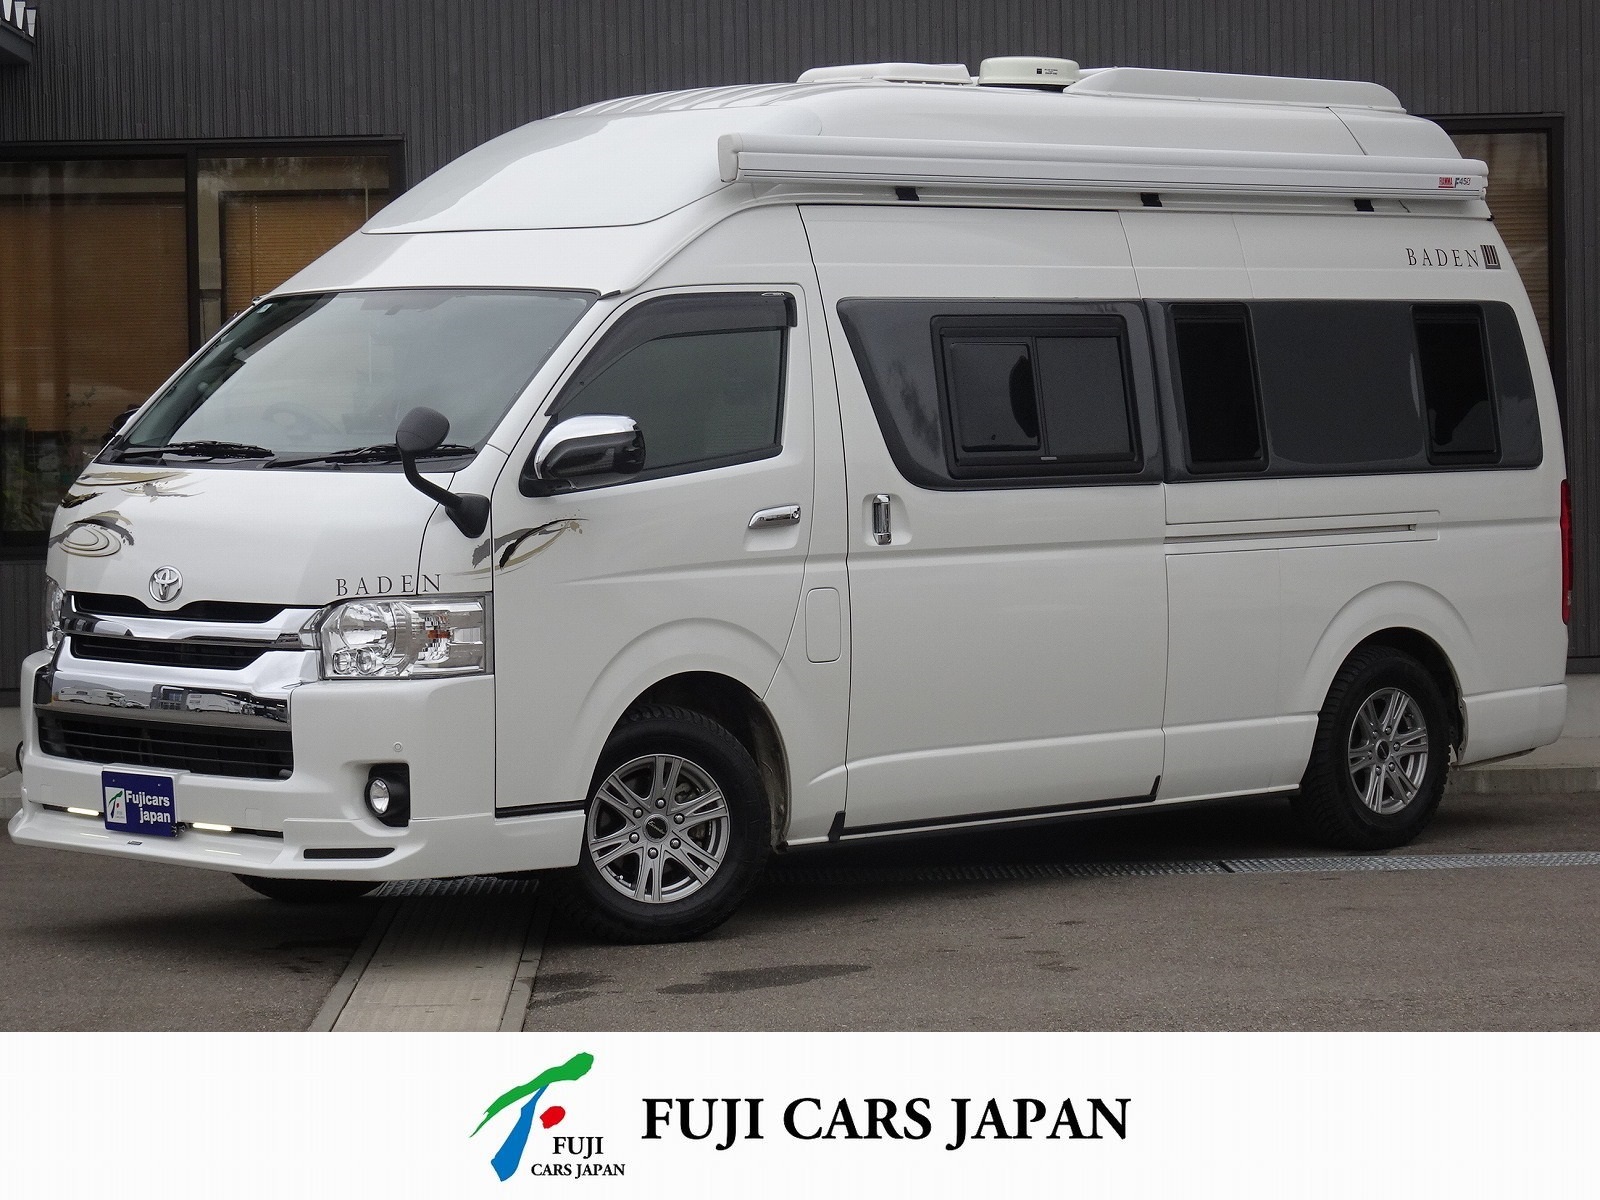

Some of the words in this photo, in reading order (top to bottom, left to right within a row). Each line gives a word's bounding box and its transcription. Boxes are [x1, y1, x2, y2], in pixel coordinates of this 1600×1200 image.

[1405, 247, 1479, 268] BADEN
[335, 573, 441, 597] BADEN
[125, 789, 170, 808] Fujicars
[140, 807, 171, 824] japan
